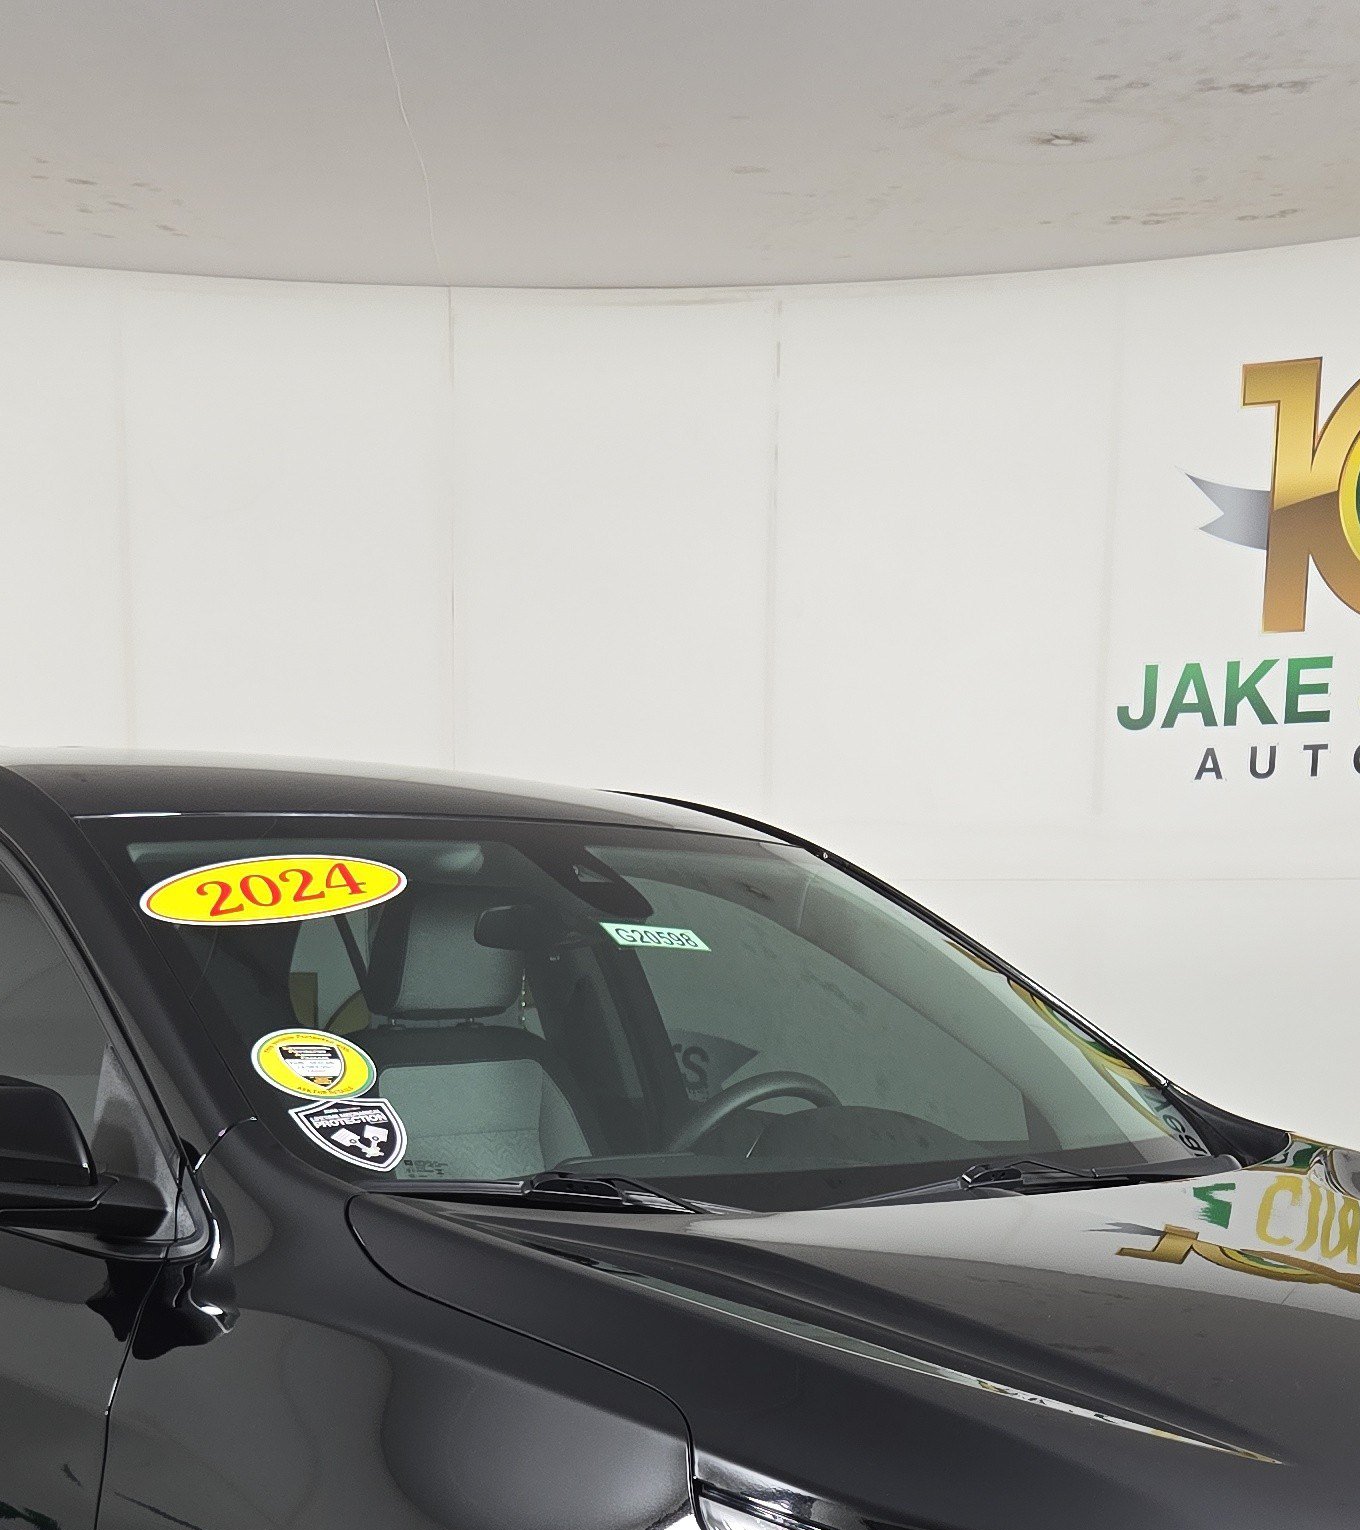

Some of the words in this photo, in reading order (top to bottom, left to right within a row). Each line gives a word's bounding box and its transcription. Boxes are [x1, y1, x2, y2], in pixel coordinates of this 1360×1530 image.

[1116, 655, 1334, 731] JAKE
[196, 863, 369, 917] 2024
[614, 928, 699, 948] G20598
[315, 1113, 388, 1129] PROTECTION
